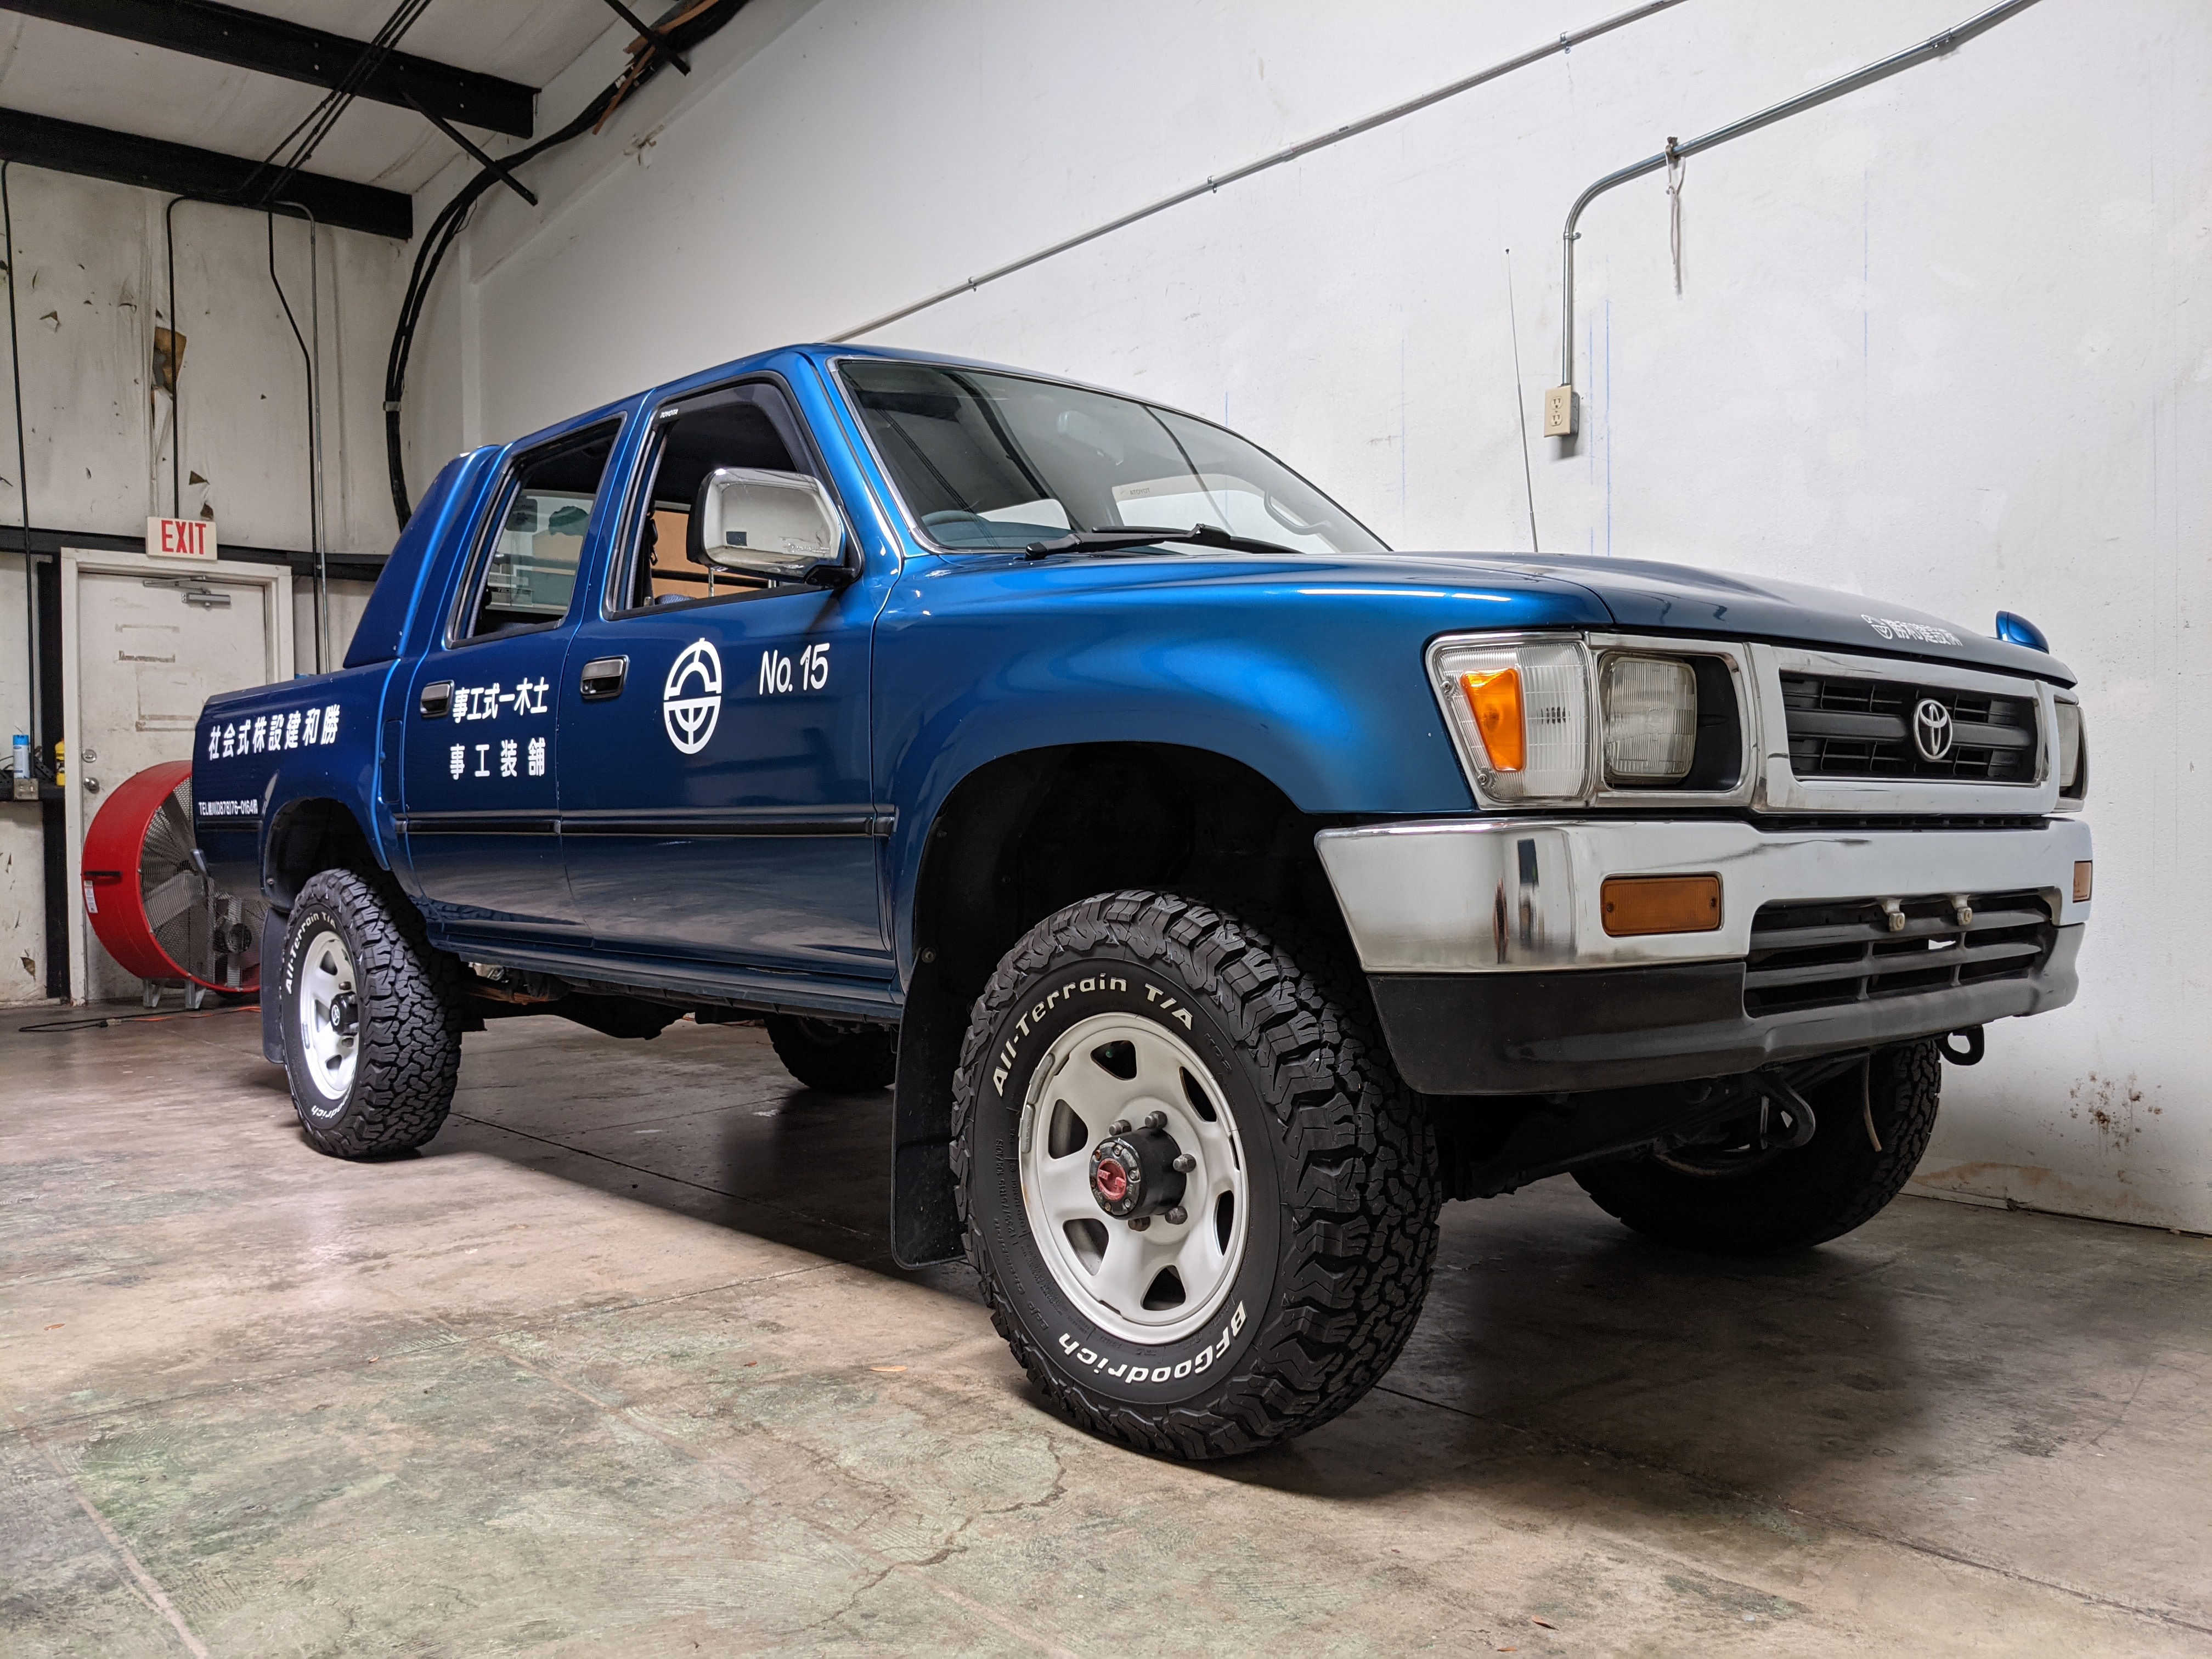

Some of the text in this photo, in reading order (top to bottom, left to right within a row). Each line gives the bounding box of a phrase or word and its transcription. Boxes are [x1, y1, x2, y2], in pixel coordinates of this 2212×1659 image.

[660, 408, 679, 419] TOYOTA
[161, 520, 206, 555] EXIT
[759, 643, 830, 695] No. 15
[286, 912, 319, 995] All-Terrain
[992, 973, 1127, 1097] All-Terrain
[1145, 983, 1194, 1031] T/A
[1059, 1300, 1248, 1384] BFGoodrich
